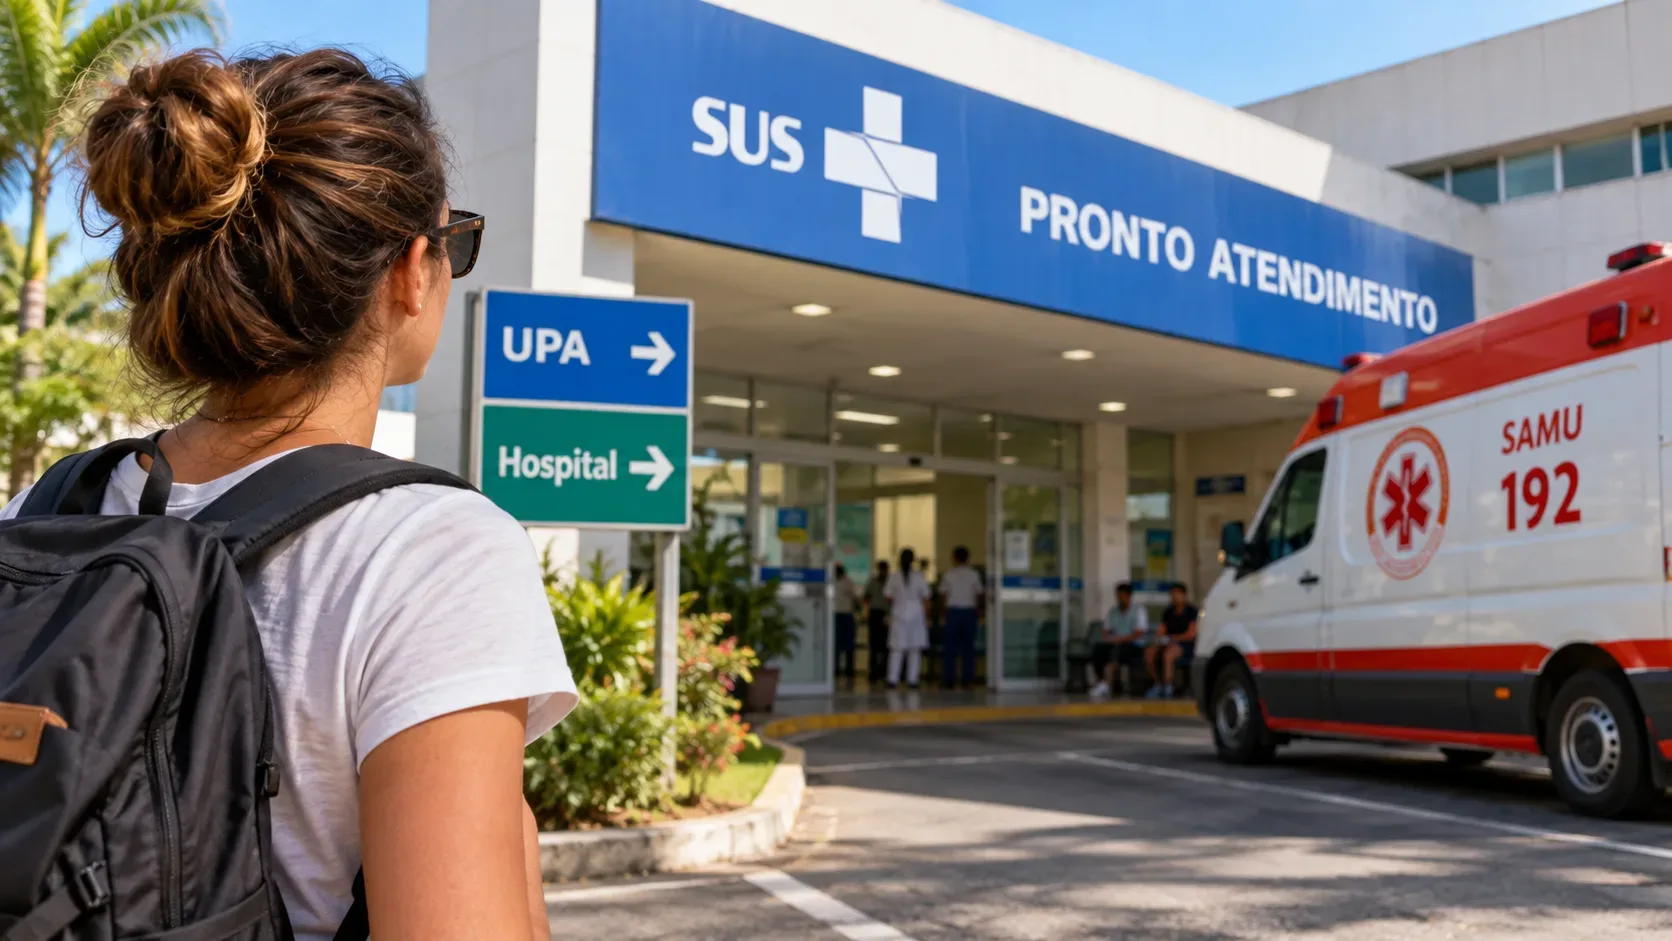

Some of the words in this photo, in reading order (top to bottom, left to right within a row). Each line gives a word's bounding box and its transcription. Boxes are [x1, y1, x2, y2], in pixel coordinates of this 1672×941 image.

[692, 96, 805, 174] SUS
[1020, 185, 1195, 272] PRONTO
[1208, 238, 1440, 334] ATENDIMENTO
[502, 326, 591, 366] UPA
[1501, 404, 1584, 455] SAMU
[498, 445, 618, 488] Hospital
[1500, 460, 1582, 532] 192
